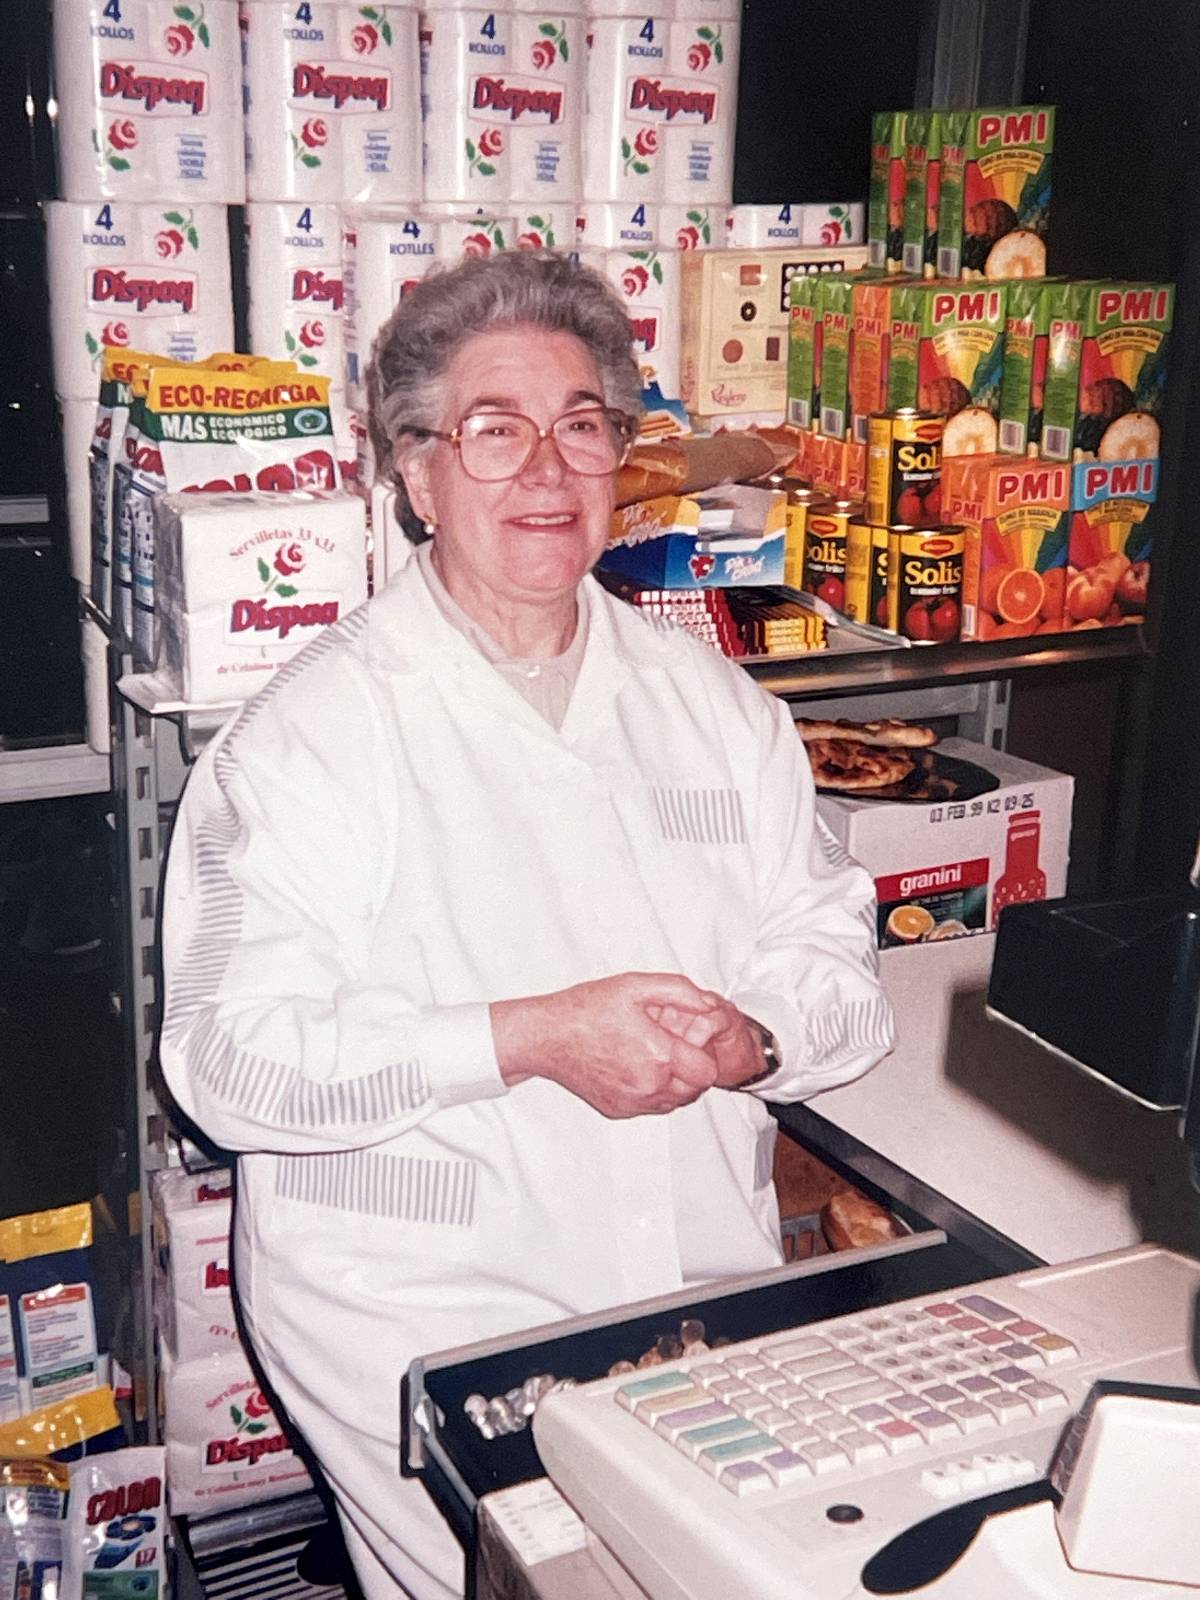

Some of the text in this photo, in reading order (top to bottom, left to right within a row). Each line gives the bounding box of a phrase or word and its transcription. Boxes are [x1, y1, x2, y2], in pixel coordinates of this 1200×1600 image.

[103, 0, 119, 22] 4
[296, 2, 312, 25] 4
[481, 14, 495, 39] 4
[640, 18, 654, 42] 4
[469, 43, 505, 57] ROLLOS
[628, 45, 663, 58] ROLLOS
[978, 113, 1047, 146] PMI
[95, 204, 113, 231] 4
[296, 208, 312, 233] 4
[631, 204, 645, 227] 4
[778, 204, 791, 224] 4
[401, 220, 420, 238] 4
[389, 241, 434, 256] ROTLLES
[934, 292, 999, 323] PMI
[1098, 291, 1168, 322] PMI
[160, 412, 287, 440] MAS ECONOMICO
[1000, 471, 1062, 503] PMI
[1086, 464, 1153, 497] PMI
[905, 560, 962, 586] Solis
[900, 864, 962, 897] granini
